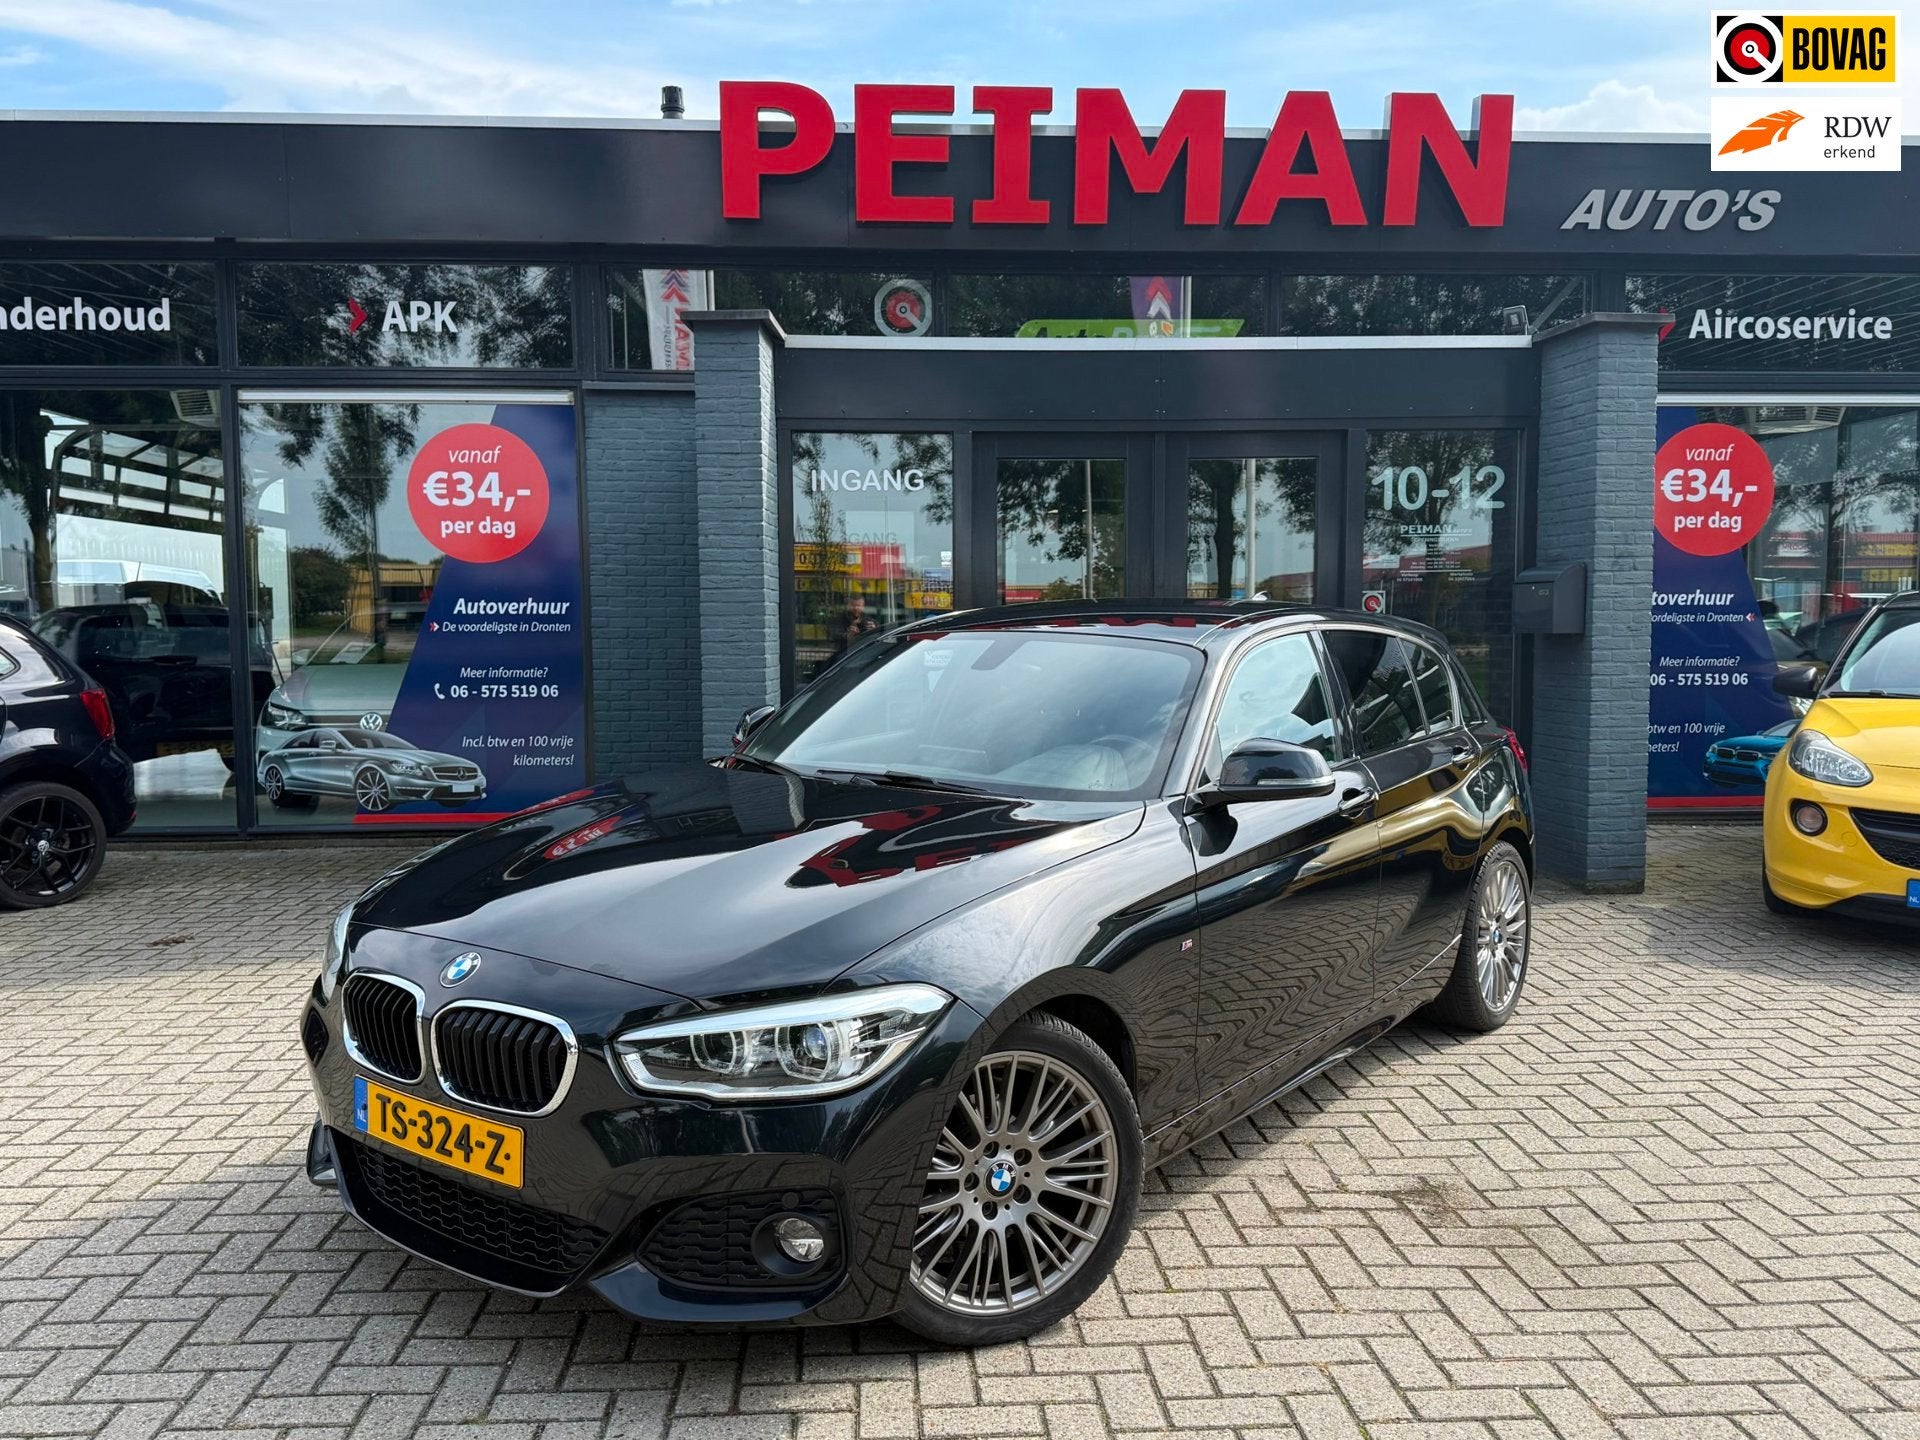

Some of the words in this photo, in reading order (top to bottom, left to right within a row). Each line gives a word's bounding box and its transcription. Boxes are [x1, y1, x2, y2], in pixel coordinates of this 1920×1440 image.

[719, 81, 1514, 228] PEIMAN
[1560, 189, 1781, 231] AUTO'S
[381, 301, 458, 333] APK
[1688, 309, 1893, 340] Aircoservice
[449, 445, 502, 464] vanaf
[1686, 444, 1735, 461] vanaf
[811, 469, 925, 491] INGANG
[1371, 465, 1506, 511] 10-12
[1660, 468, 1758, 507] €34,-
[423, 471, 531, 512] €34,-
[441, 519, 474, 538] per
[478, 516, 516, 539] dag
[1400, 524, 1453, 534] PEIMAN
[1674, 515, 1704, 532] per
[1708, 511, 1742, 532] dag
[453, 597, 570, 615] Autoverhuur
[1696, 612, 1706, 622] in
[1707, 612, 1744, 622] Dronten
[442, 621, 457, 632] De
[458, 621, 518, 634] voordeligste
[520, 621, 529, 632] in
[530, 621, 571, 632] Dronten
[1659, 656, 1685, 667] Meer
[1685, 656, 1741, 667] informatie?
[460, 667, 487, 678] Meer
[488, 666, 548, 678] informatie?
[1650, 673, 1667, 686] 06
[1677, 673, 1702, 686] 575
[1705, 673, 1729, 686] 519
[1732, 673, 1749, 686] 06
[450, 684, 469, 697] 06
[481, 684, 508, 697] 575
[511, 684, 538, 697] 519
[541, 684, 559, 697] 06
[1668, 725, 1681, 733] en
[1684, 722, 1702, 733] 100
[1703, 722, 1725, 736] vrije
[462, 736, 485, 747] Incl.
[487, 736, 510, 747] btw
[511, 738, 525, 747] en
[528, 736, 549, 747] 100
[550, 736, 574, 749] vrije
[513, 754, 575, 766] kilometers!
[357, 1107, 367, 1123] NL
[375, 1093, 505, 1175] TS-324-Z
